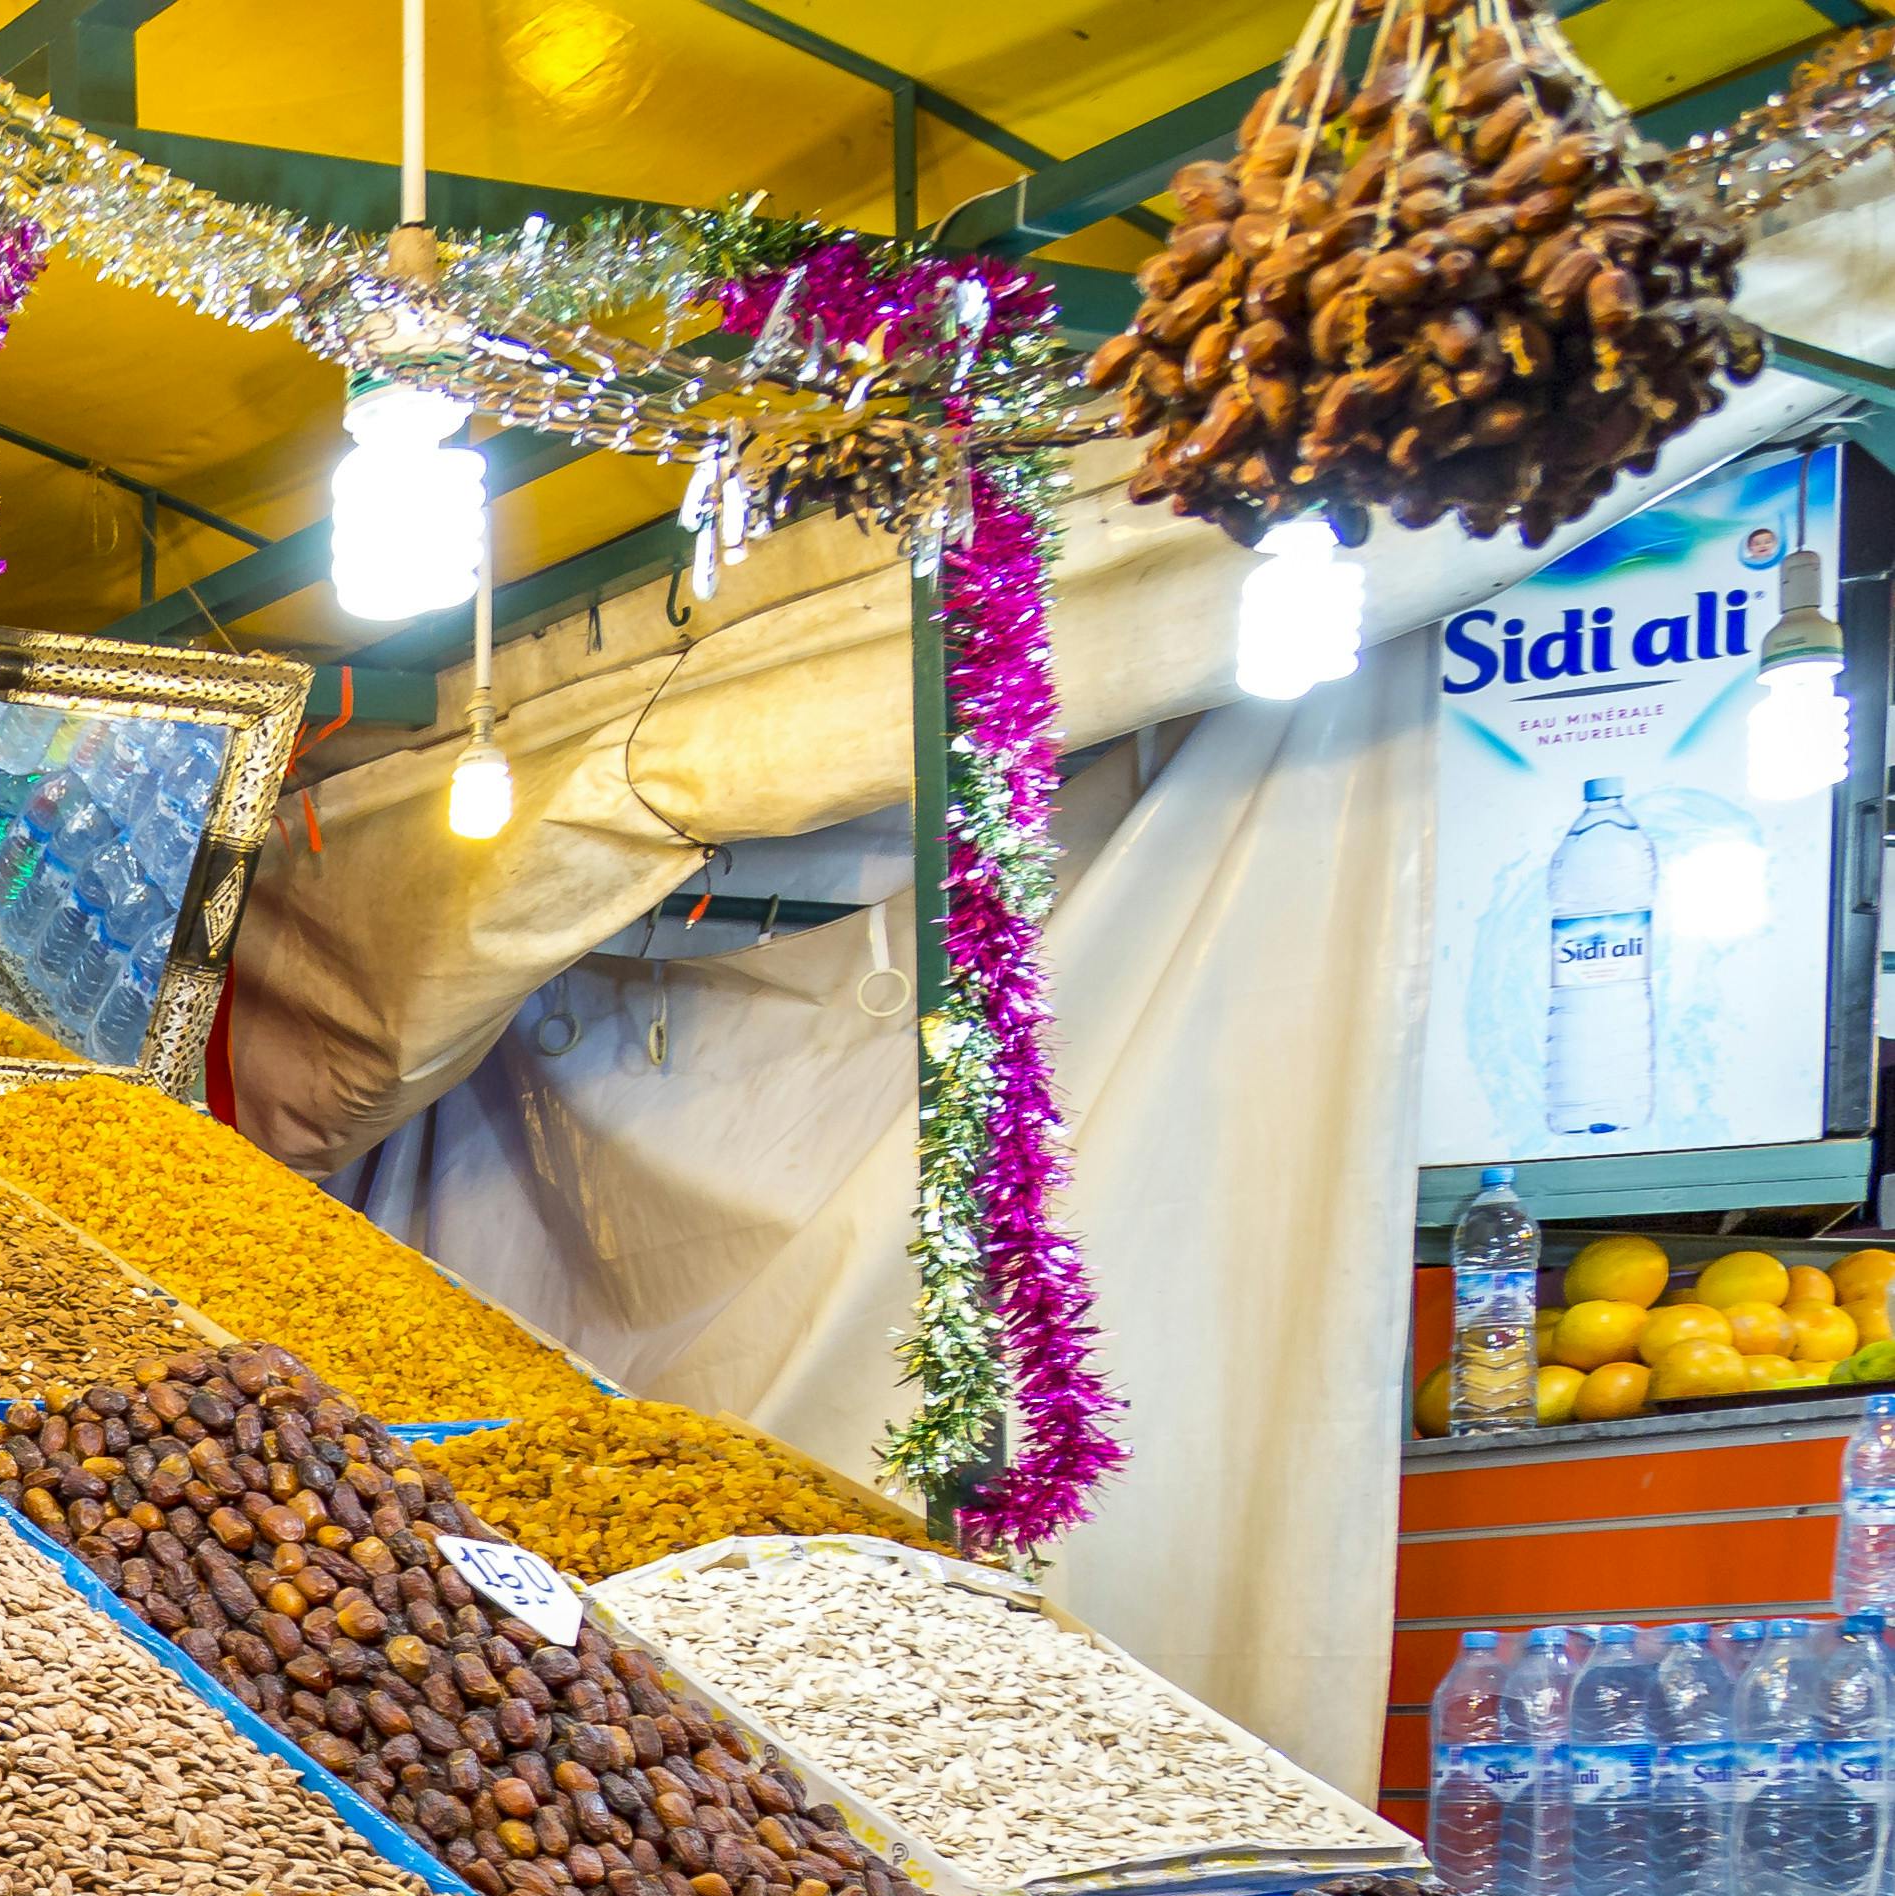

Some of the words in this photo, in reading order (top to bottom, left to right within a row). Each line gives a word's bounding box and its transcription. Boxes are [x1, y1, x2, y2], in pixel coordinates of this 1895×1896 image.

[1443, 606, 1618, 695] Sidi
[1632, 589, 1752, 668] ali
[1519, 718, 1557, 733] EAU
[1565, 704, 1666, 726] MINÉRALE
[1537, 722, 1649, 746] NATURELLE
[1558, 939, 1607, 963] Sidi
[1612, 937, 1644, 957] ali
